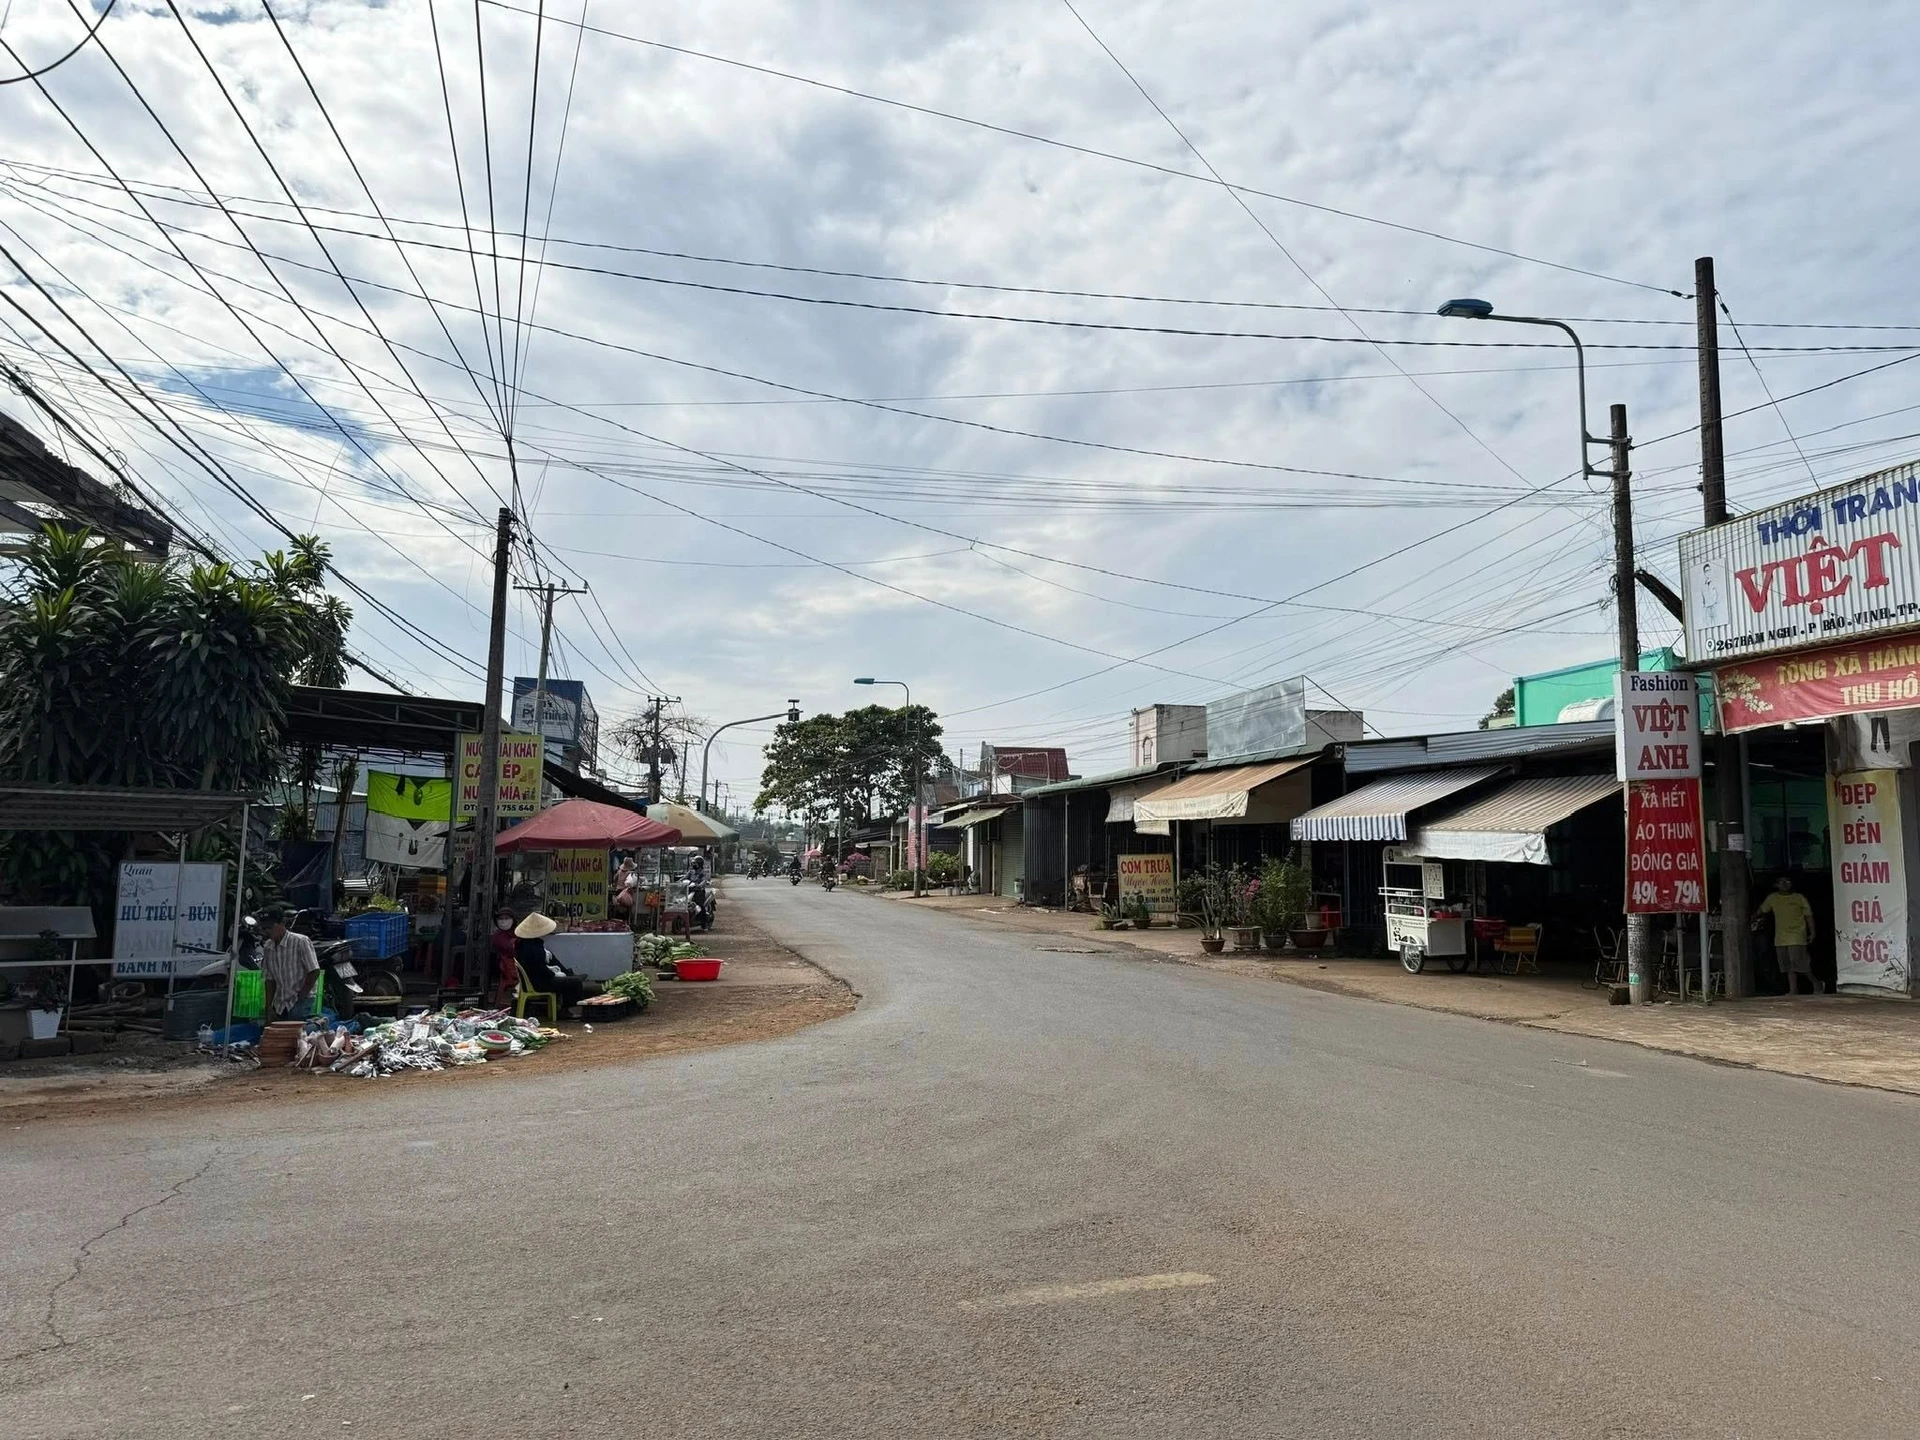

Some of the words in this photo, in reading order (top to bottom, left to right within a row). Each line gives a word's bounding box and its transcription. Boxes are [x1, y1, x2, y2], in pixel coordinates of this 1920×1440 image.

[1831, 475, 1920, 525] TRAN
[1734, 532, 1902, 615] VIỆT
[1630, 675, 1689, 691] Fashion
[1840, 682, 1881, 706] THU
[1632, 697, 1690, 739] VIỆT
[514, 739, 538, 758] KHÁT
[1638, 744, 1690, 770] ANH
[502, 760, 521, 779] ÉP
[499, 783, 520, 800] MÍA
[1641, 785, 1659, 808] XẢ
[1662, 784, 1686, 808] HẾT
[1841, 782, 1877, 809] ĐẸP
[519, 804, 535, 812] 648
[1635, 819, 1655, 840] ÁO
[1659, 822, 1694, 840] THUN
[1843, 816, 1882, 845] BỀN
[1631, 846, 1672, 871] ĐỒNG
[1676, 848, 1699, 871] GIÁ
[1840, 853, 1891, 884] GIẢM
[1632, 881, 1658, 904] 49k
[1674, 880, 1701, 904] 79k
[121, 899, 142, 920] HỦ
[145, 898, 177, 921] TIẾU
[188, 902, 217, 921] BÚN
[1851, 895, 1884, 923] GIÁ
[1851, 932, 1889, 963] SỐC
[117, 953, 157, 973] BÁNH
